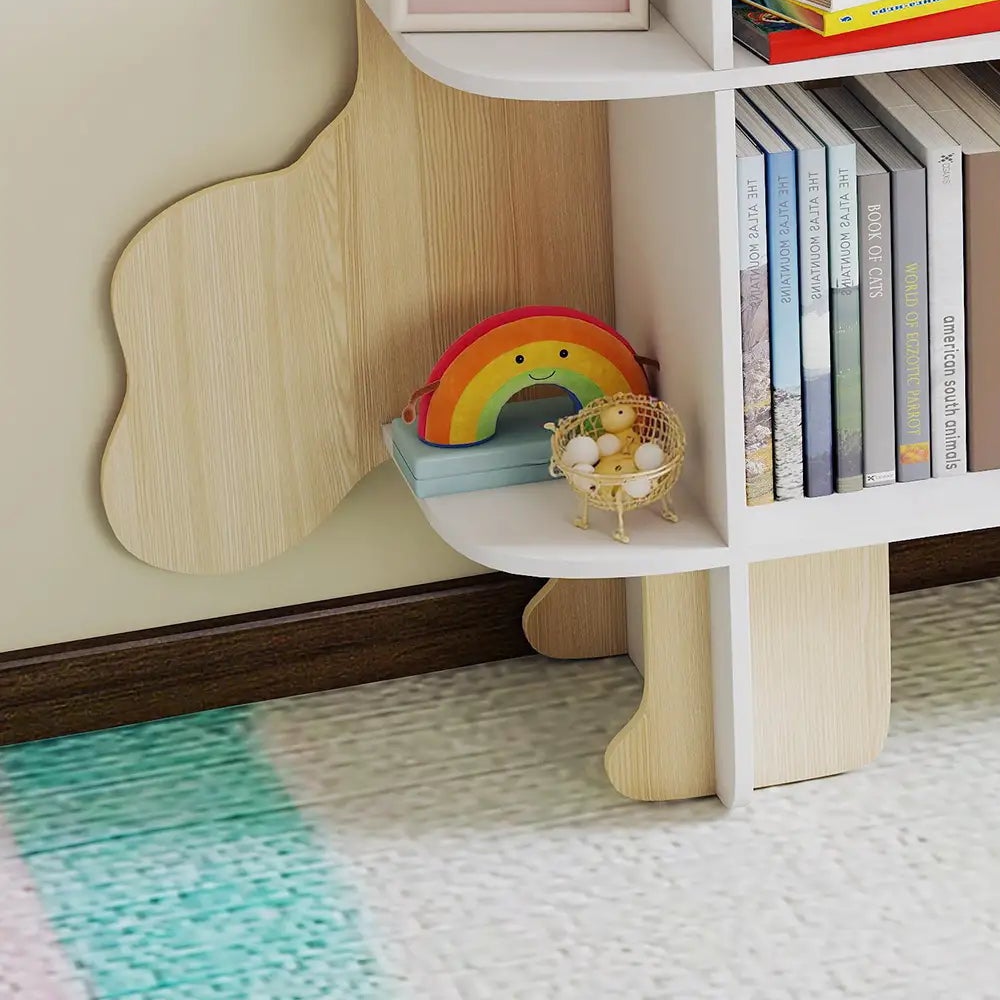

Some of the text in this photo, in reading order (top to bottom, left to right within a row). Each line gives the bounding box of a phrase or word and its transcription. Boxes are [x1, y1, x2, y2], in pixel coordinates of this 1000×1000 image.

[867, 204, 883, 298] BOOK OF CATS
[905, 262, 919, 307] WORLD
[905, 311, 919, 327] OF
[906, 389, 922, 435] PARROT
[943, 315, 961, 470] american south animals
